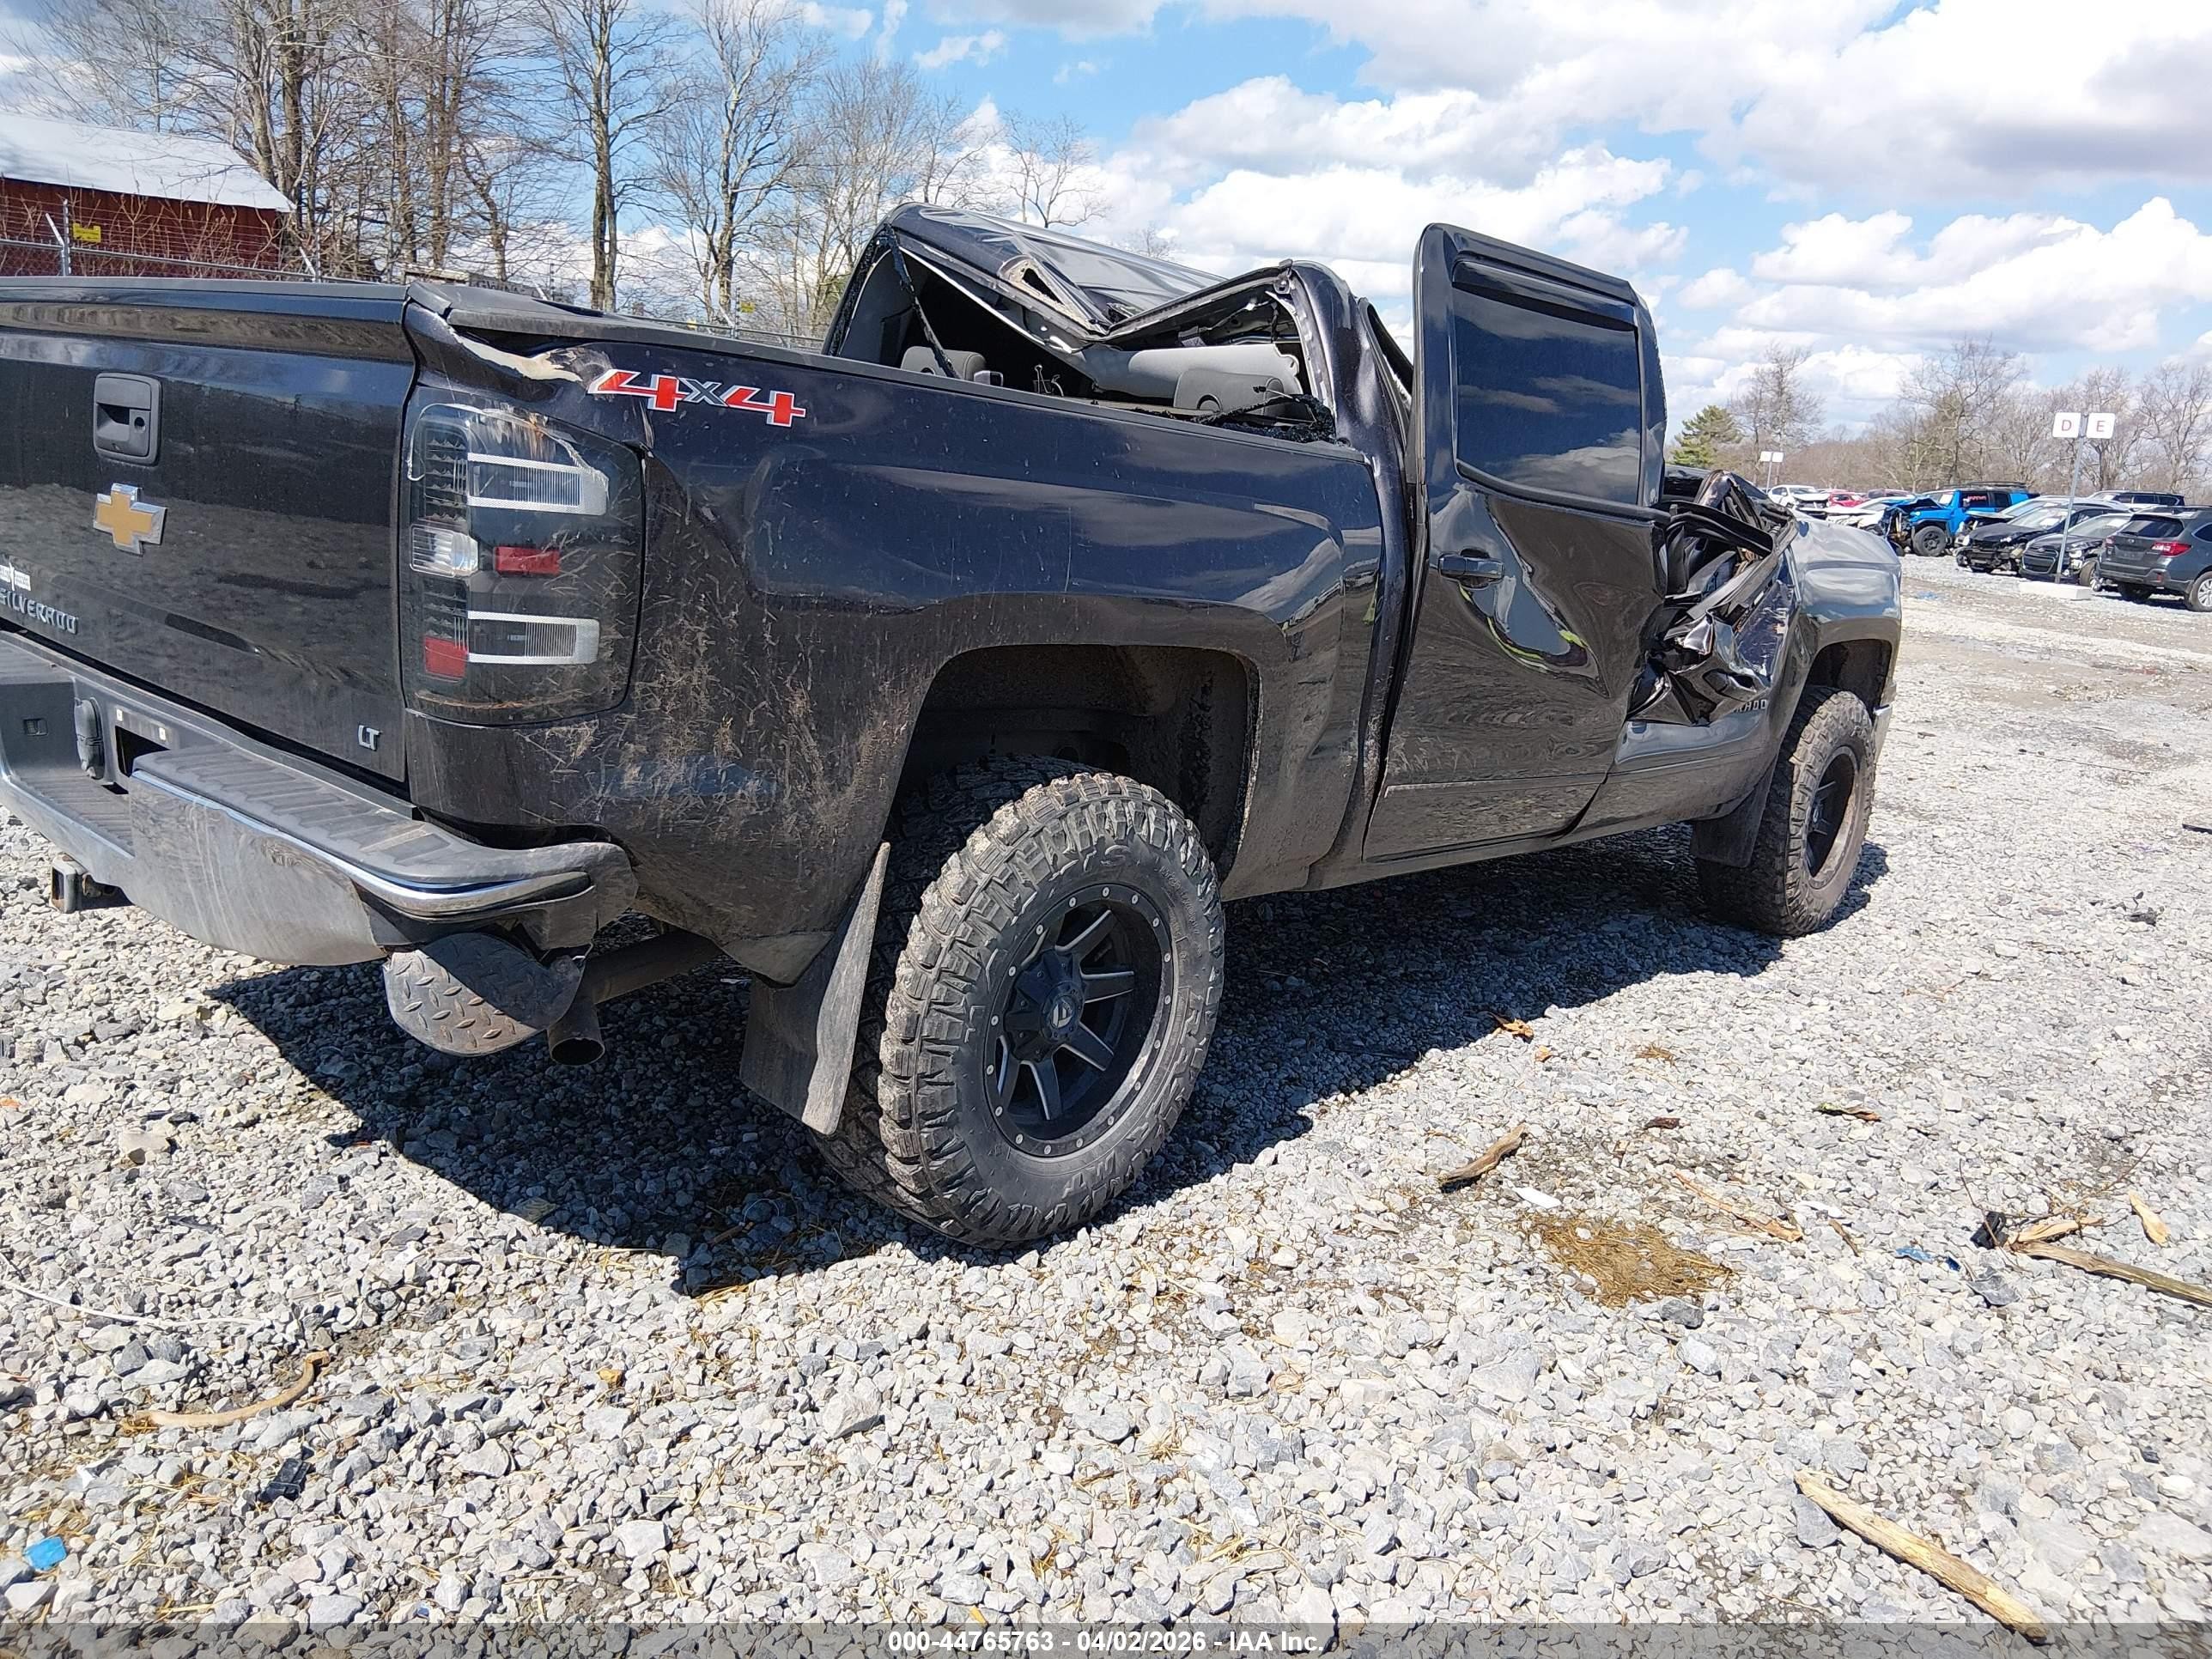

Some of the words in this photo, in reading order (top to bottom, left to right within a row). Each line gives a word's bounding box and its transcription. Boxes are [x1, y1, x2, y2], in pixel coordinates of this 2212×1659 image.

[2061, 419, 2072, 432] D
[2096, 420, 2106, 433] E
[0, 587, 77, 635] SILVERADO
[357, 725, 380, 750] LT
